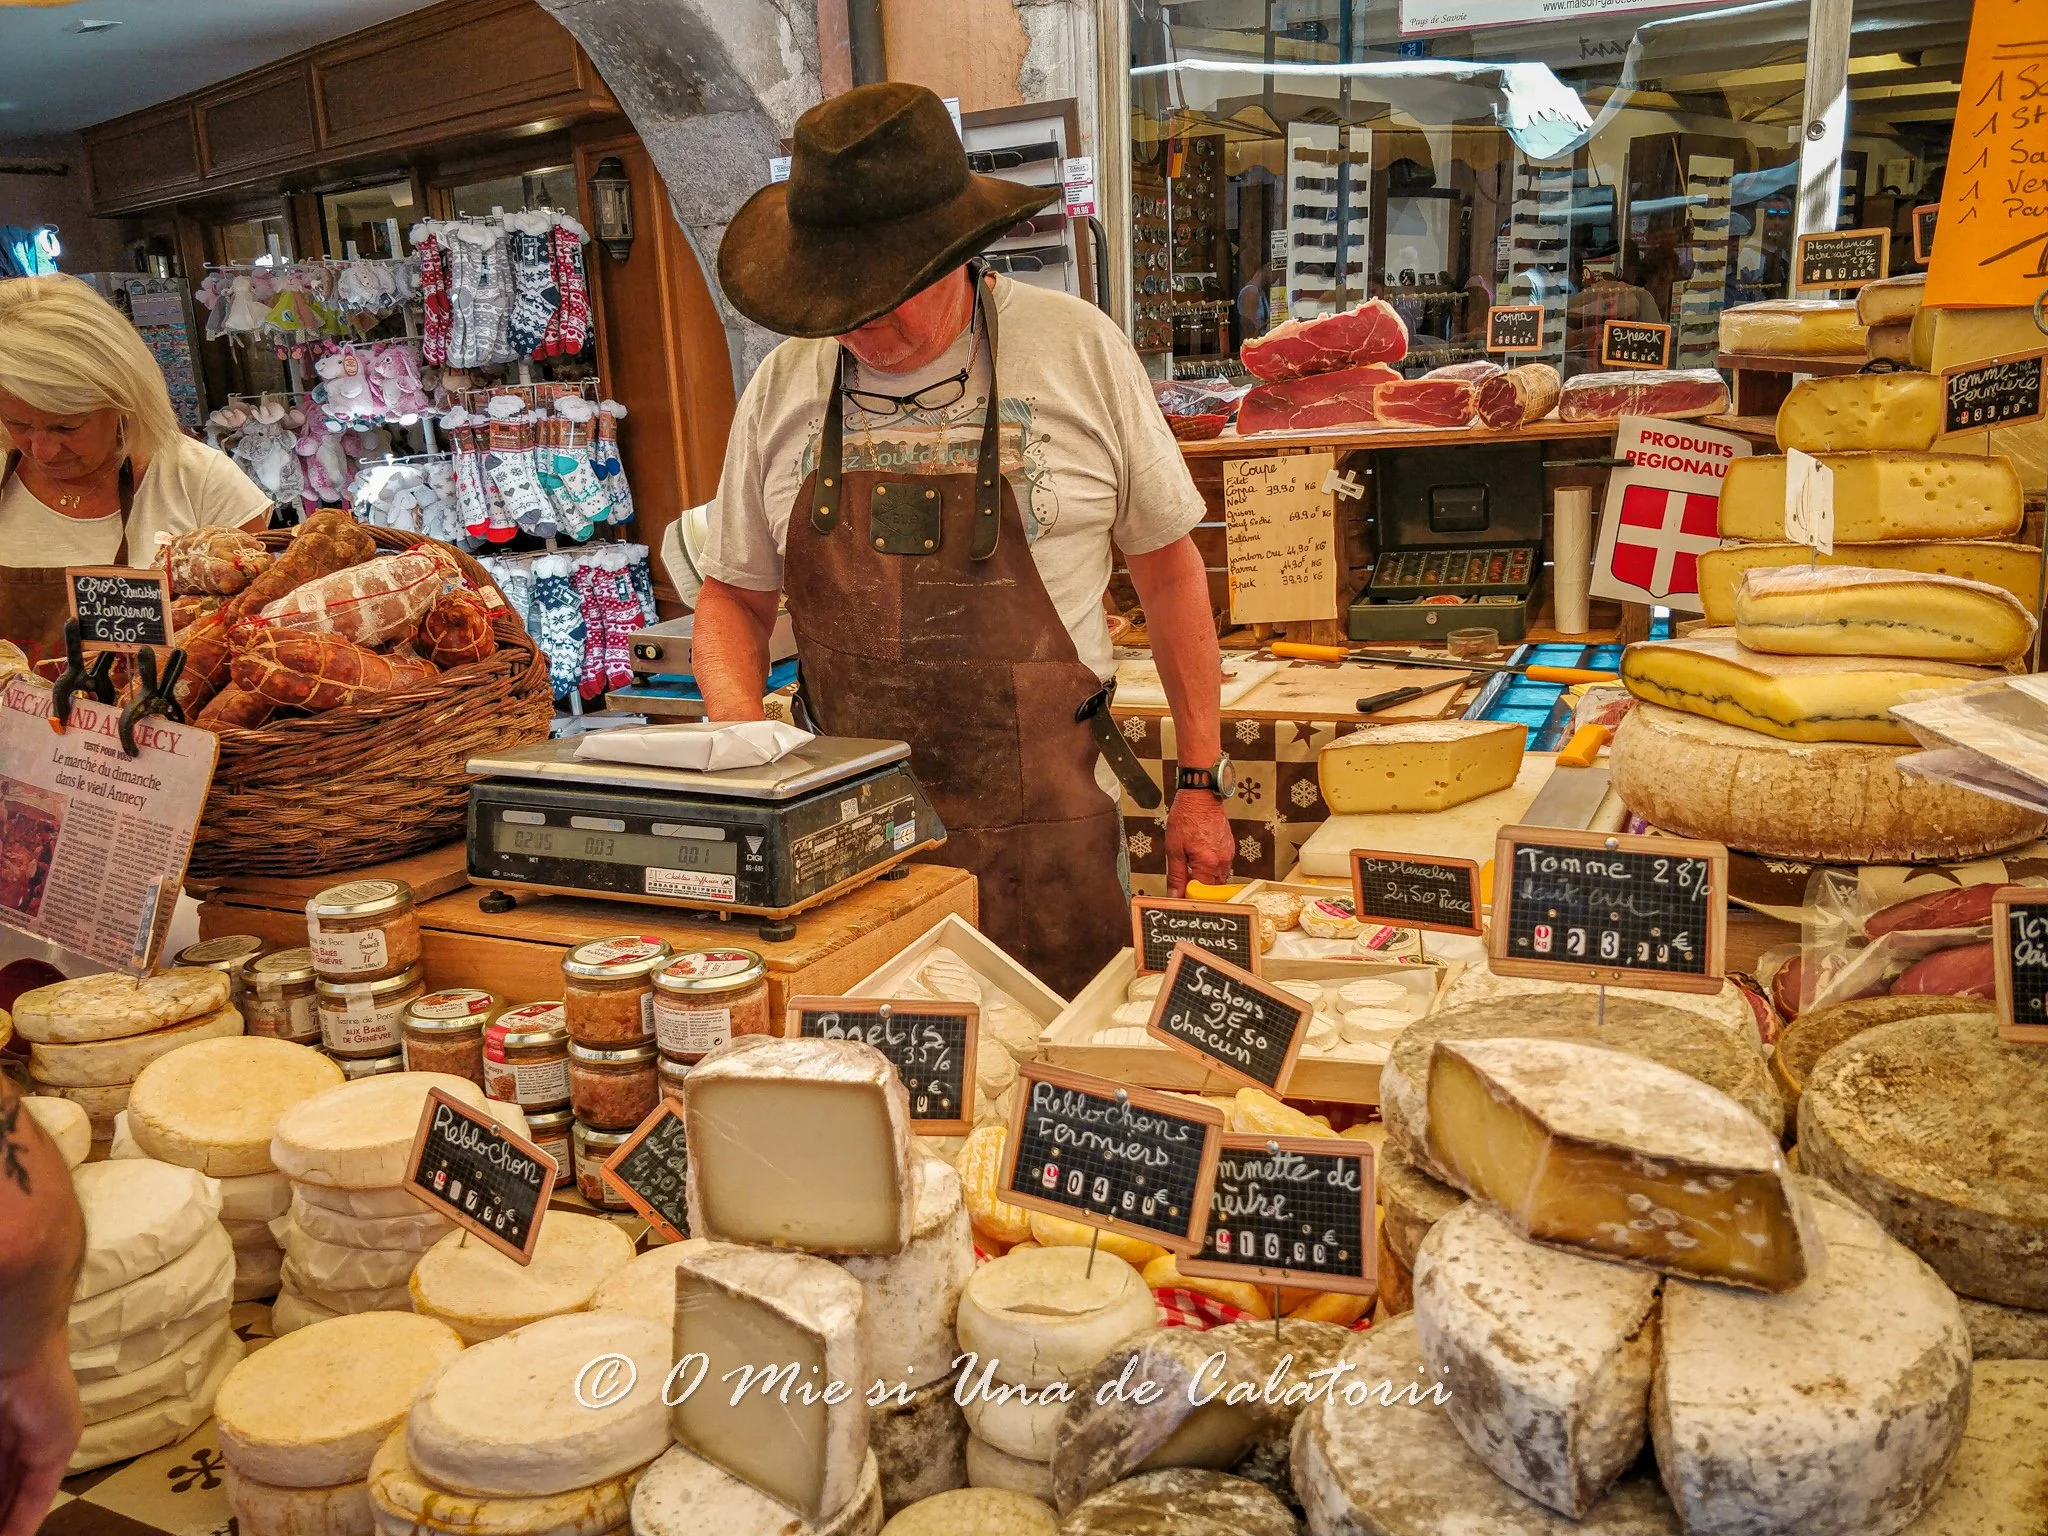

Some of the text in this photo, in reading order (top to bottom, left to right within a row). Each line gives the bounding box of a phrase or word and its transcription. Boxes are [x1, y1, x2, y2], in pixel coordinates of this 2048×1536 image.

[1409, 12, 1468, 27] Pays de Savoie
[1807, 239, 1874, 251] Abondance
[1495, 312, 1534, 326] Coppa
[1612, 328, 1663, 345] Speeck
[1948, 364, 2017, 393] Tomme
[1640, 430, 1734, 459] PRODUITS
[1625, 450, 1729, 478] REGIONAU
[1226, 477, 1249, 486] Filet
[1226, 485, 1258, 498] Coppa
[1304, 482, 1317, 491] KG
[1227, 495, 1248, 507] Noix
[1228, 531, 1261, 545] Salami
[1315, 541, 1327, 551] KG
[1230, 565, 1258, 576] Parme
[83, 741, 99, 753] TESTÉ
[100, 746, 116, 757] POUR
[52, 748, 162, 791] Le marché du dimanche
[56, 770, 148, 811] dans le vieil Annecy
[746, 854, 763, 862] DIGI
[1365, 857, 1384, 873] St
[1517, 848, 1714, 901] Tomme 28%
[362, 1014, 373, 1024] de
[376, 1012, 394, 1022] Porc
[343, 1031, 393, 1044] DE GENIÈVRE
[345, 1024, 387, 1035] AUX BAIES
[902, 1046, 952, 1072] 35%
[1033, 1081, 1190, 1142] Reblochons
[1218, 1151, 1362, 1191] mmette de
